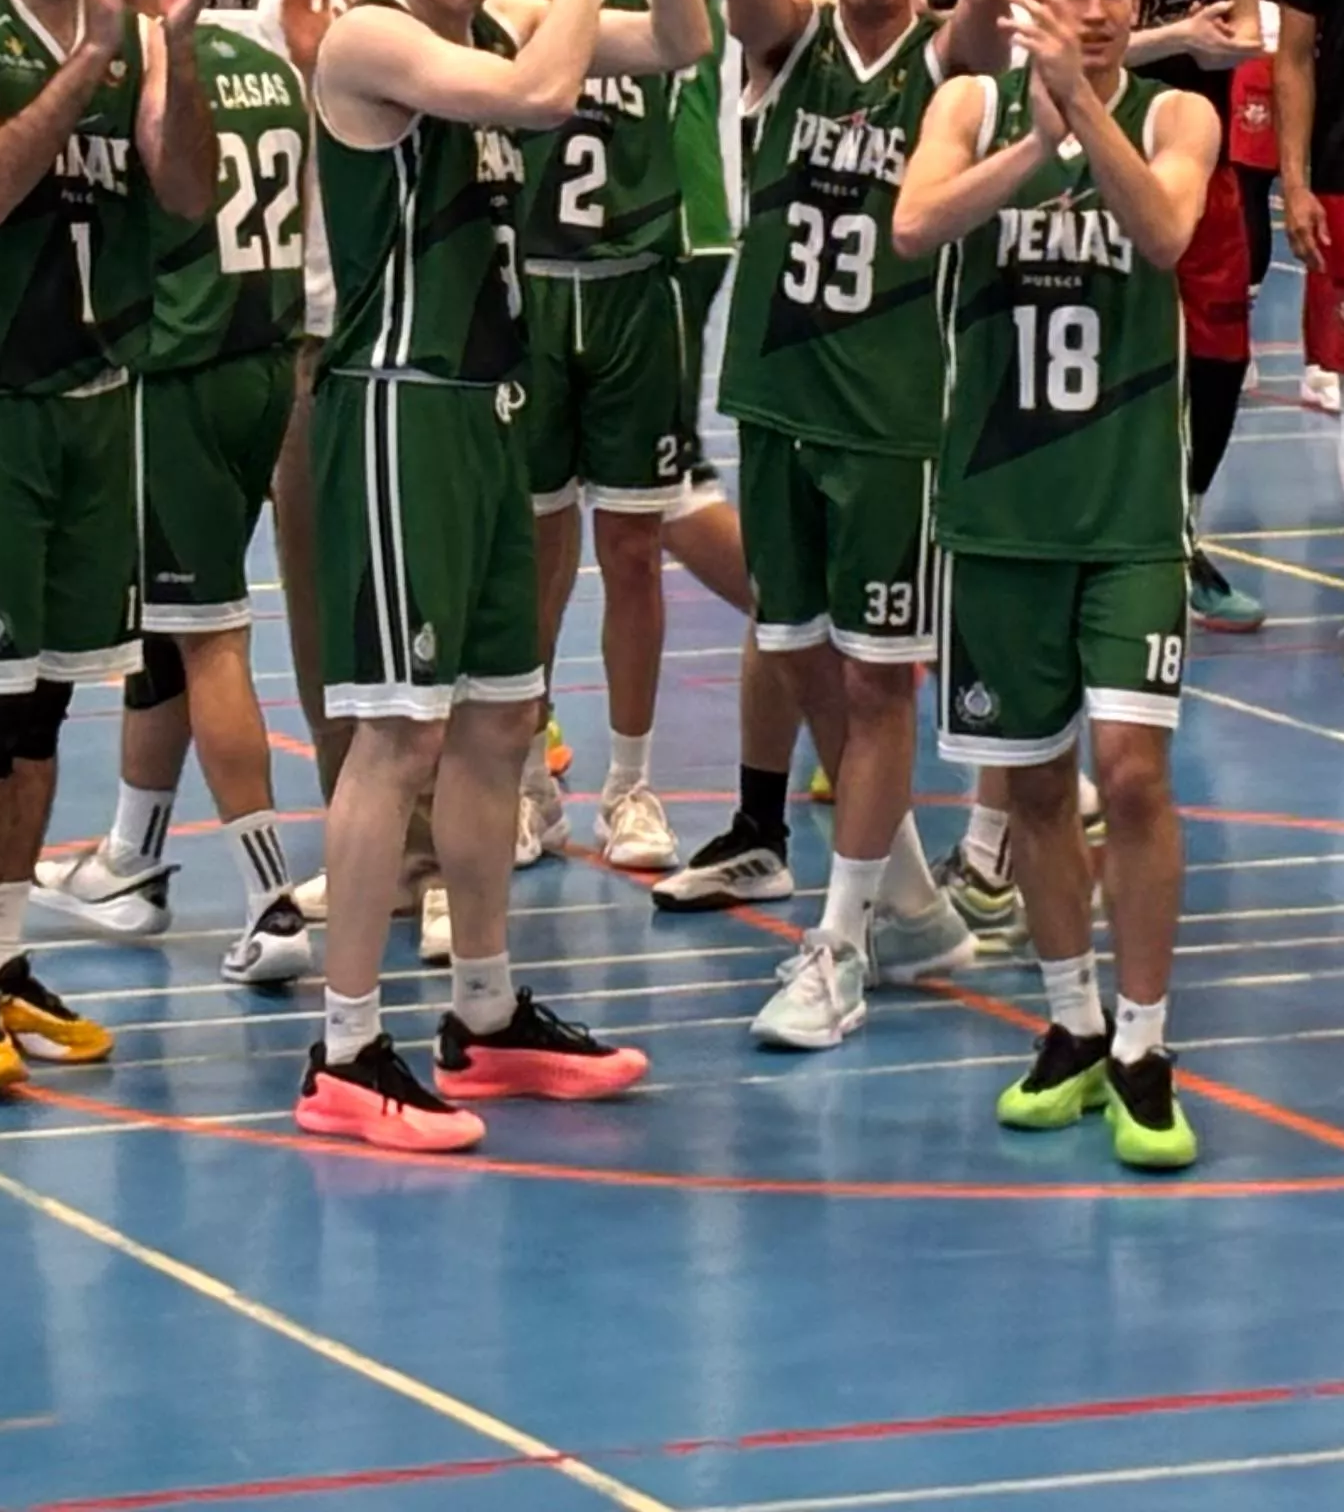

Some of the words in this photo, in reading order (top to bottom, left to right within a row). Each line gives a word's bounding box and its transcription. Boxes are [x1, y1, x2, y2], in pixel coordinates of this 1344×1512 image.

[215, 127, 303, 274] 22
[559, 134, 608, 229] 2
[783, 201, 877, 313] 33
[1012, 304, 1100, 412] 18
[863, 582, 913, 627] 33
[1145, 634, 1183, 685] 18
